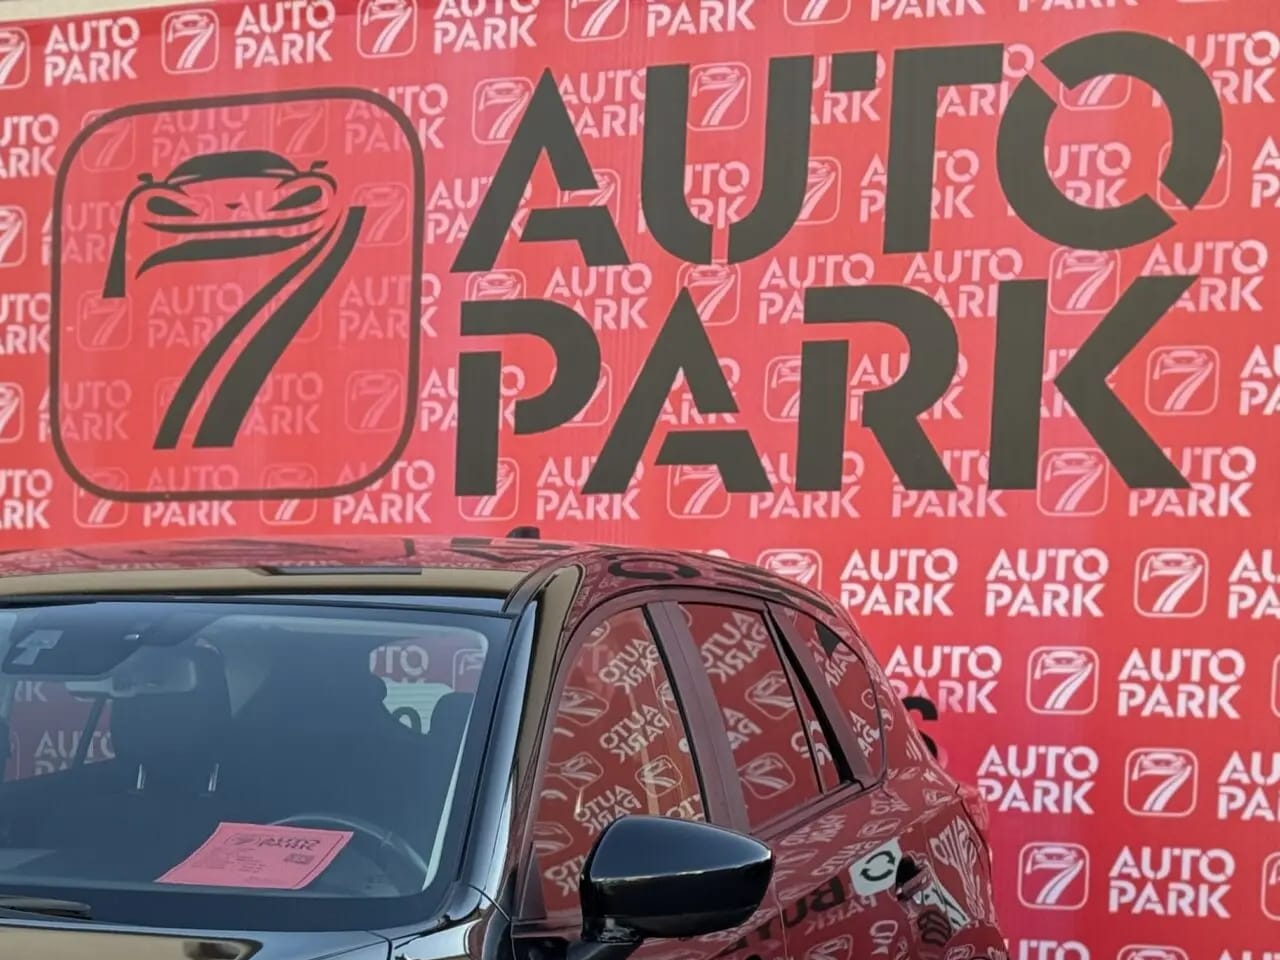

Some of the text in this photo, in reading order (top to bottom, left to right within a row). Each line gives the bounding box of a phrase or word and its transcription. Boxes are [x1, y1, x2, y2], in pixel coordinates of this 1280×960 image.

[44, 15, 140, 54] AUTO
[235, 0, 335, 36] AUTO
[433, 16, 537, 55] PARK
[646, 0, 755, 37] PARK
[45, 48, 136, 86] PARK
[235, 30, 332, 69] PARK
[450, 29, 1224, 273] AUTO
[1045, 140, 1132, 180] UTO
[759, 254, 875, 290] AUTO
[903, 247, 1023, 286] AUTO
[1141, 239, 1268, 278] AUTO
[548, 262, 653, 299] AUTO
[455, 274, 1200, 498] PARK
[244, 405, 321, 438] ARK
[146, 464, 239, 494] AUTO
[143, 500, 237, 527] PARK
[333, 492, 432, 525] PARK
[536, 489, 641, 522] PARK
[748, 488, 861, 520] PARK
[891, 487, 1007, 520] PARK
[1128, 482, 1253, 520] PARK
[840, 548, 957, 581] AUTO
[986, 548, 1108, 581] AUTO
[840, 583, 953, 616] PARK
[986, 583, 1103, 616] PARK
[884, 644, 1003, 680] AUTO
[1119, 648, 1245, 683] AUTO
[1118, 683, 1240, 718] PARK
[977, 745, 1098, 779] AUTO
[977, 779, 1094, 814] PARK
[1109, 847, 1235, 883] AUTO
[1109, 880, 1230, 918] PARK
